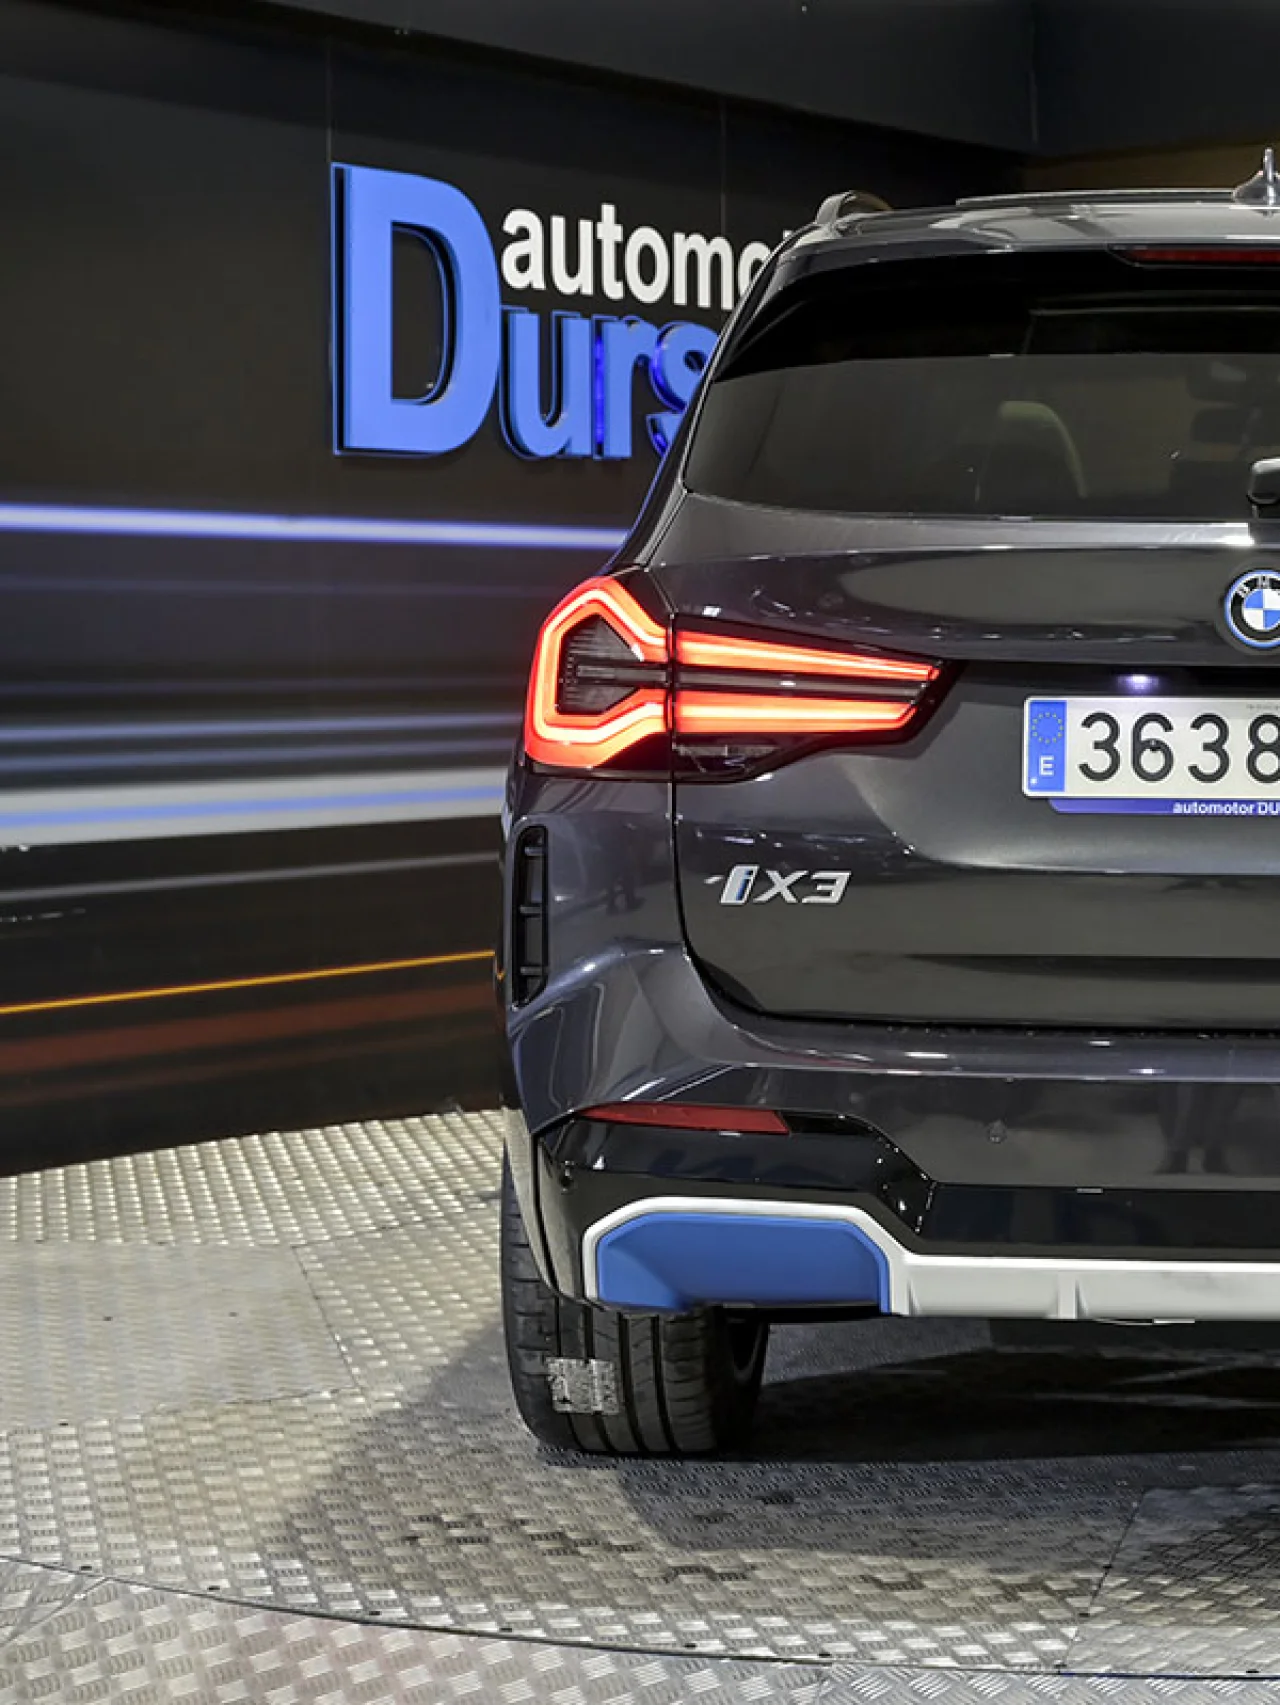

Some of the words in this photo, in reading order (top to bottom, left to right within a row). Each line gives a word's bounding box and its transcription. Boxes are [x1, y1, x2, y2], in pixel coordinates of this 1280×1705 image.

[502, 203, 792, 310] automo
[1038, 755, 1055, 776] E
[720, 864, 851, 904] iX3
